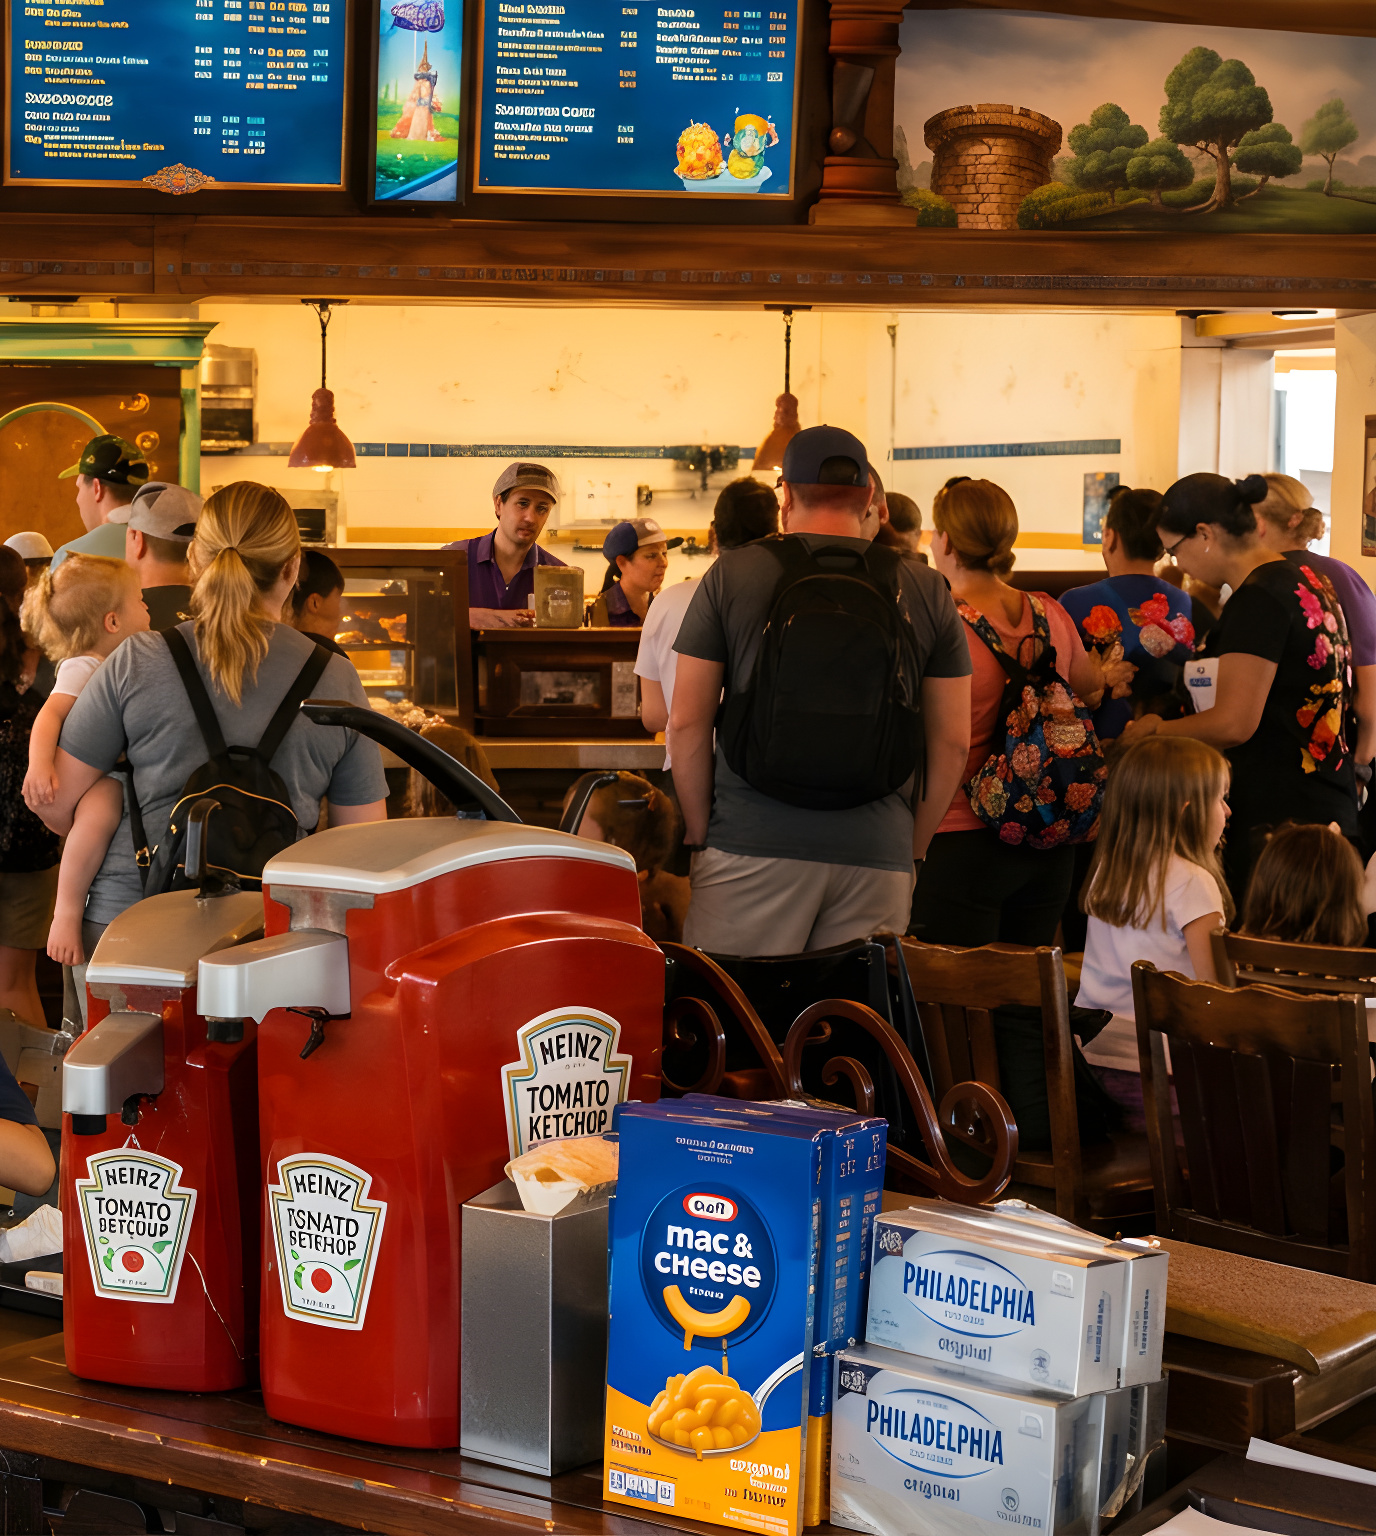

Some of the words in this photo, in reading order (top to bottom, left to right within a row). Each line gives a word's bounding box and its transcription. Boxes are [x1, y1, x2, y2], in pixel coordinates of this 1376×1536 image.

[527, 1080, 609, 1113] TOMATO
[294, 1174, 352, 1202] HEINZ
[95, 1197, 171, 1221] TOMATO
[667, 1225, 729, 1255] mac
[733, 1233, 754, 1259] &
[903, 1261, 1035, 1326] PHILADELPHIA
[867, 1399, 1004, 1465] PHILADELPHIA
